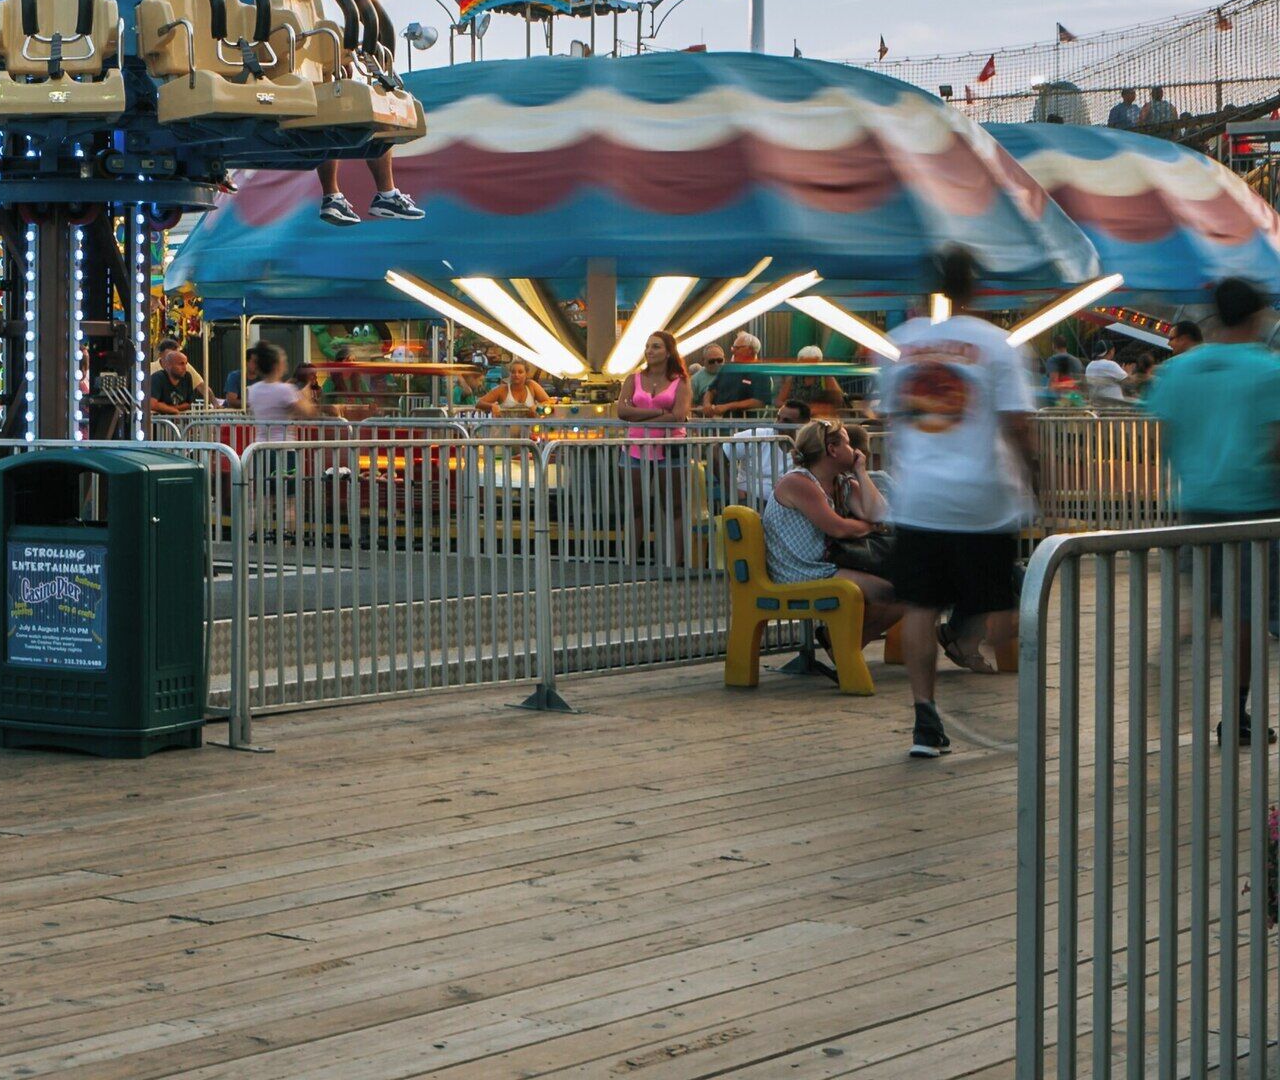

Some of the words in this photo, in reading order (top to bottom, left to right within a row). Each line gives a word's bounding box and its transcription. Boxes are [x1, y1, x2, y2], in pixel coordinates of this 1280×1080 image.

[24, 547, 86, 560] STROLLING
[11, 560, 101, 575] ENTERTAINMENT
[19, 624, 31, 632] July
[37, 625, 59, 633] August
[62, 626, 77, 634] 7-10
[77, 627, 89, 635] PM
